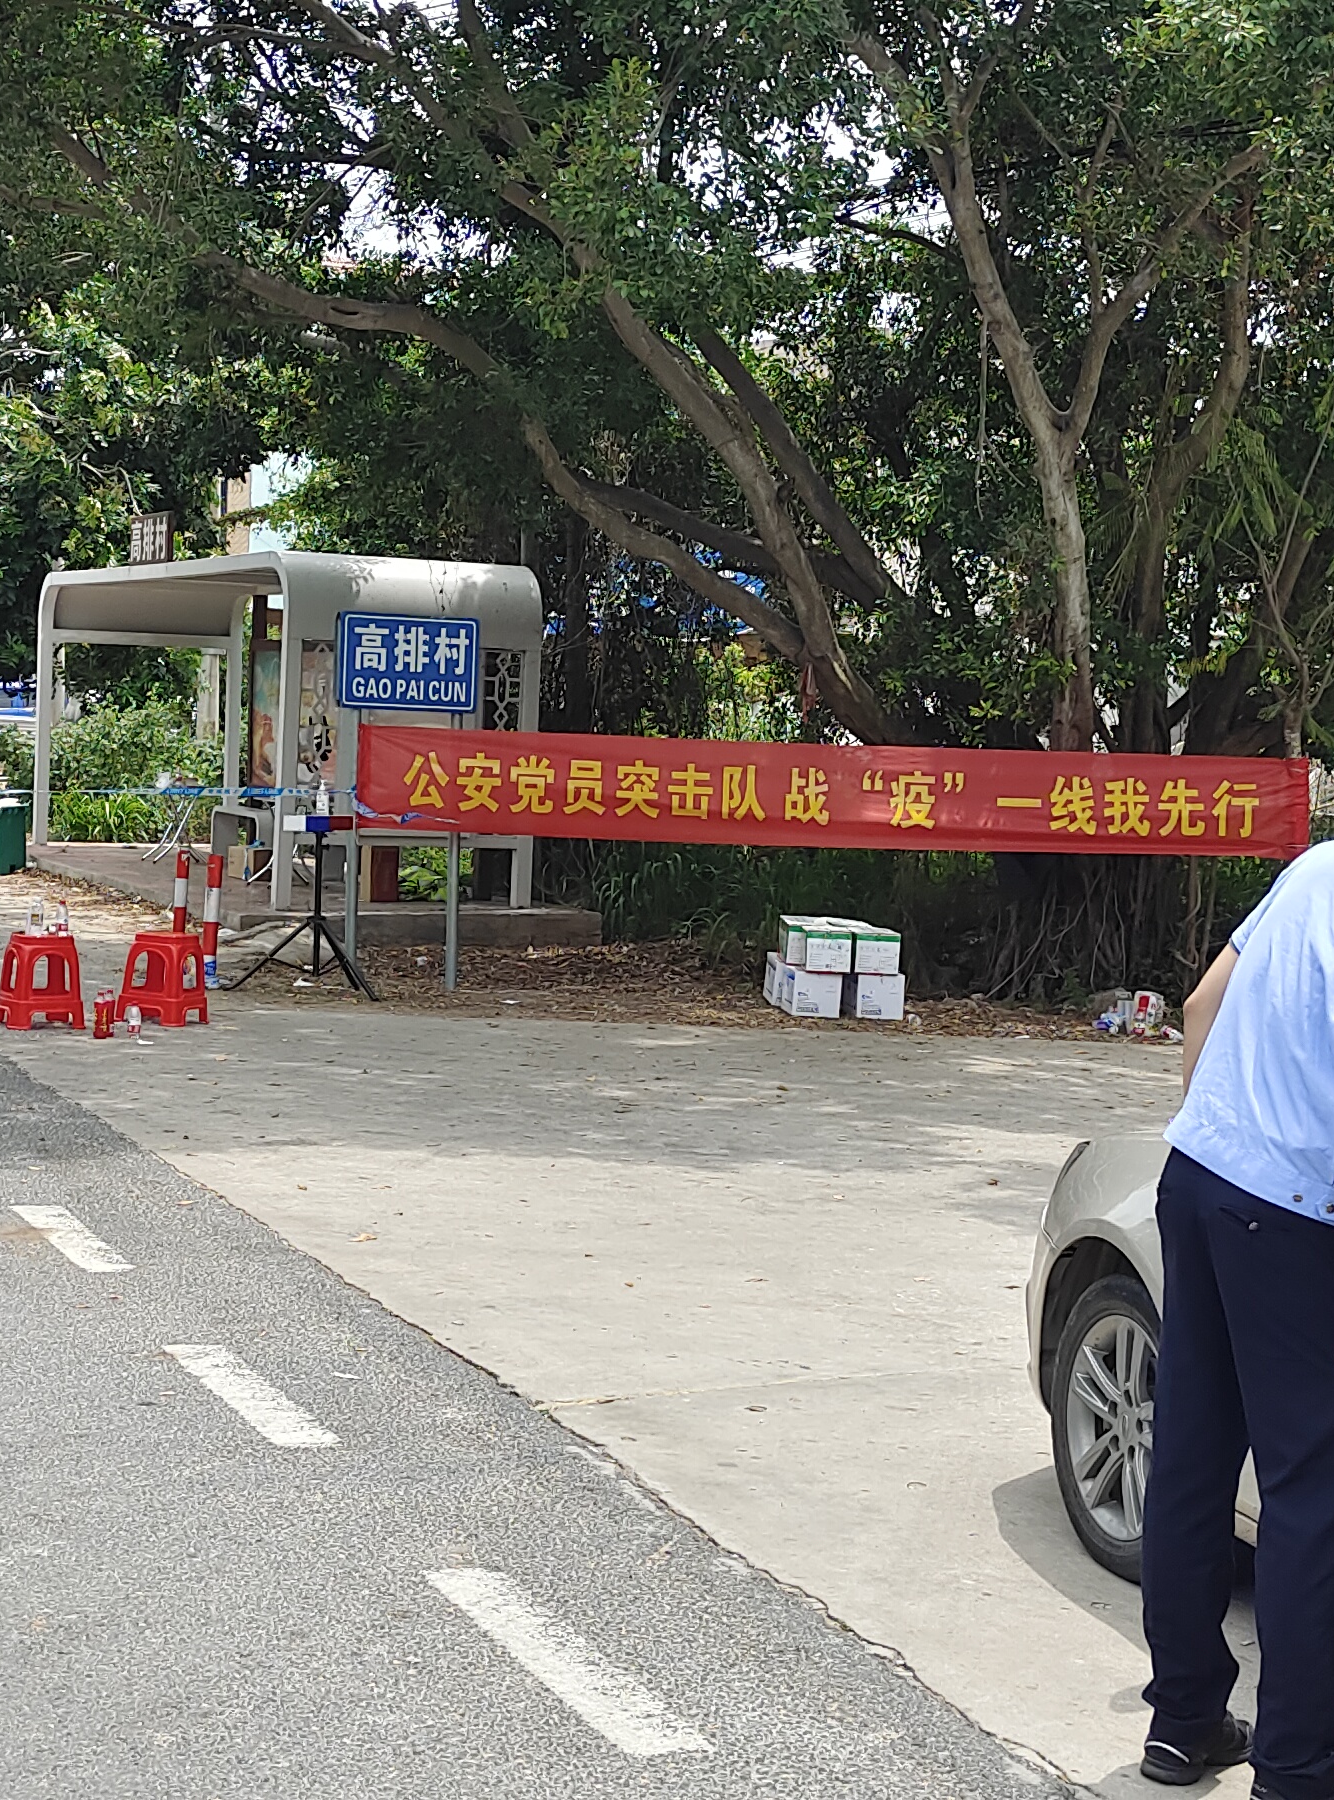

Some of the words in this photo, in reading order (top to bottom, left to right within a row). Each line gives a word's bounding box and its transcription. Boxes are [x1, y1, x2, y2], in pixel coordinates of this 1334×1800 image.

[130, 516, 167, 562] 高排村
[354, 623, 470, 676] 高排村
[352, 677, 392, 700] GAO
[395, 679, 425, 701] PAI
[428, 680, 467, 703] CUN
[403, 751, 767, 823] 公安党员突击队
[995, 775, 1261, 839] 一线我先行
